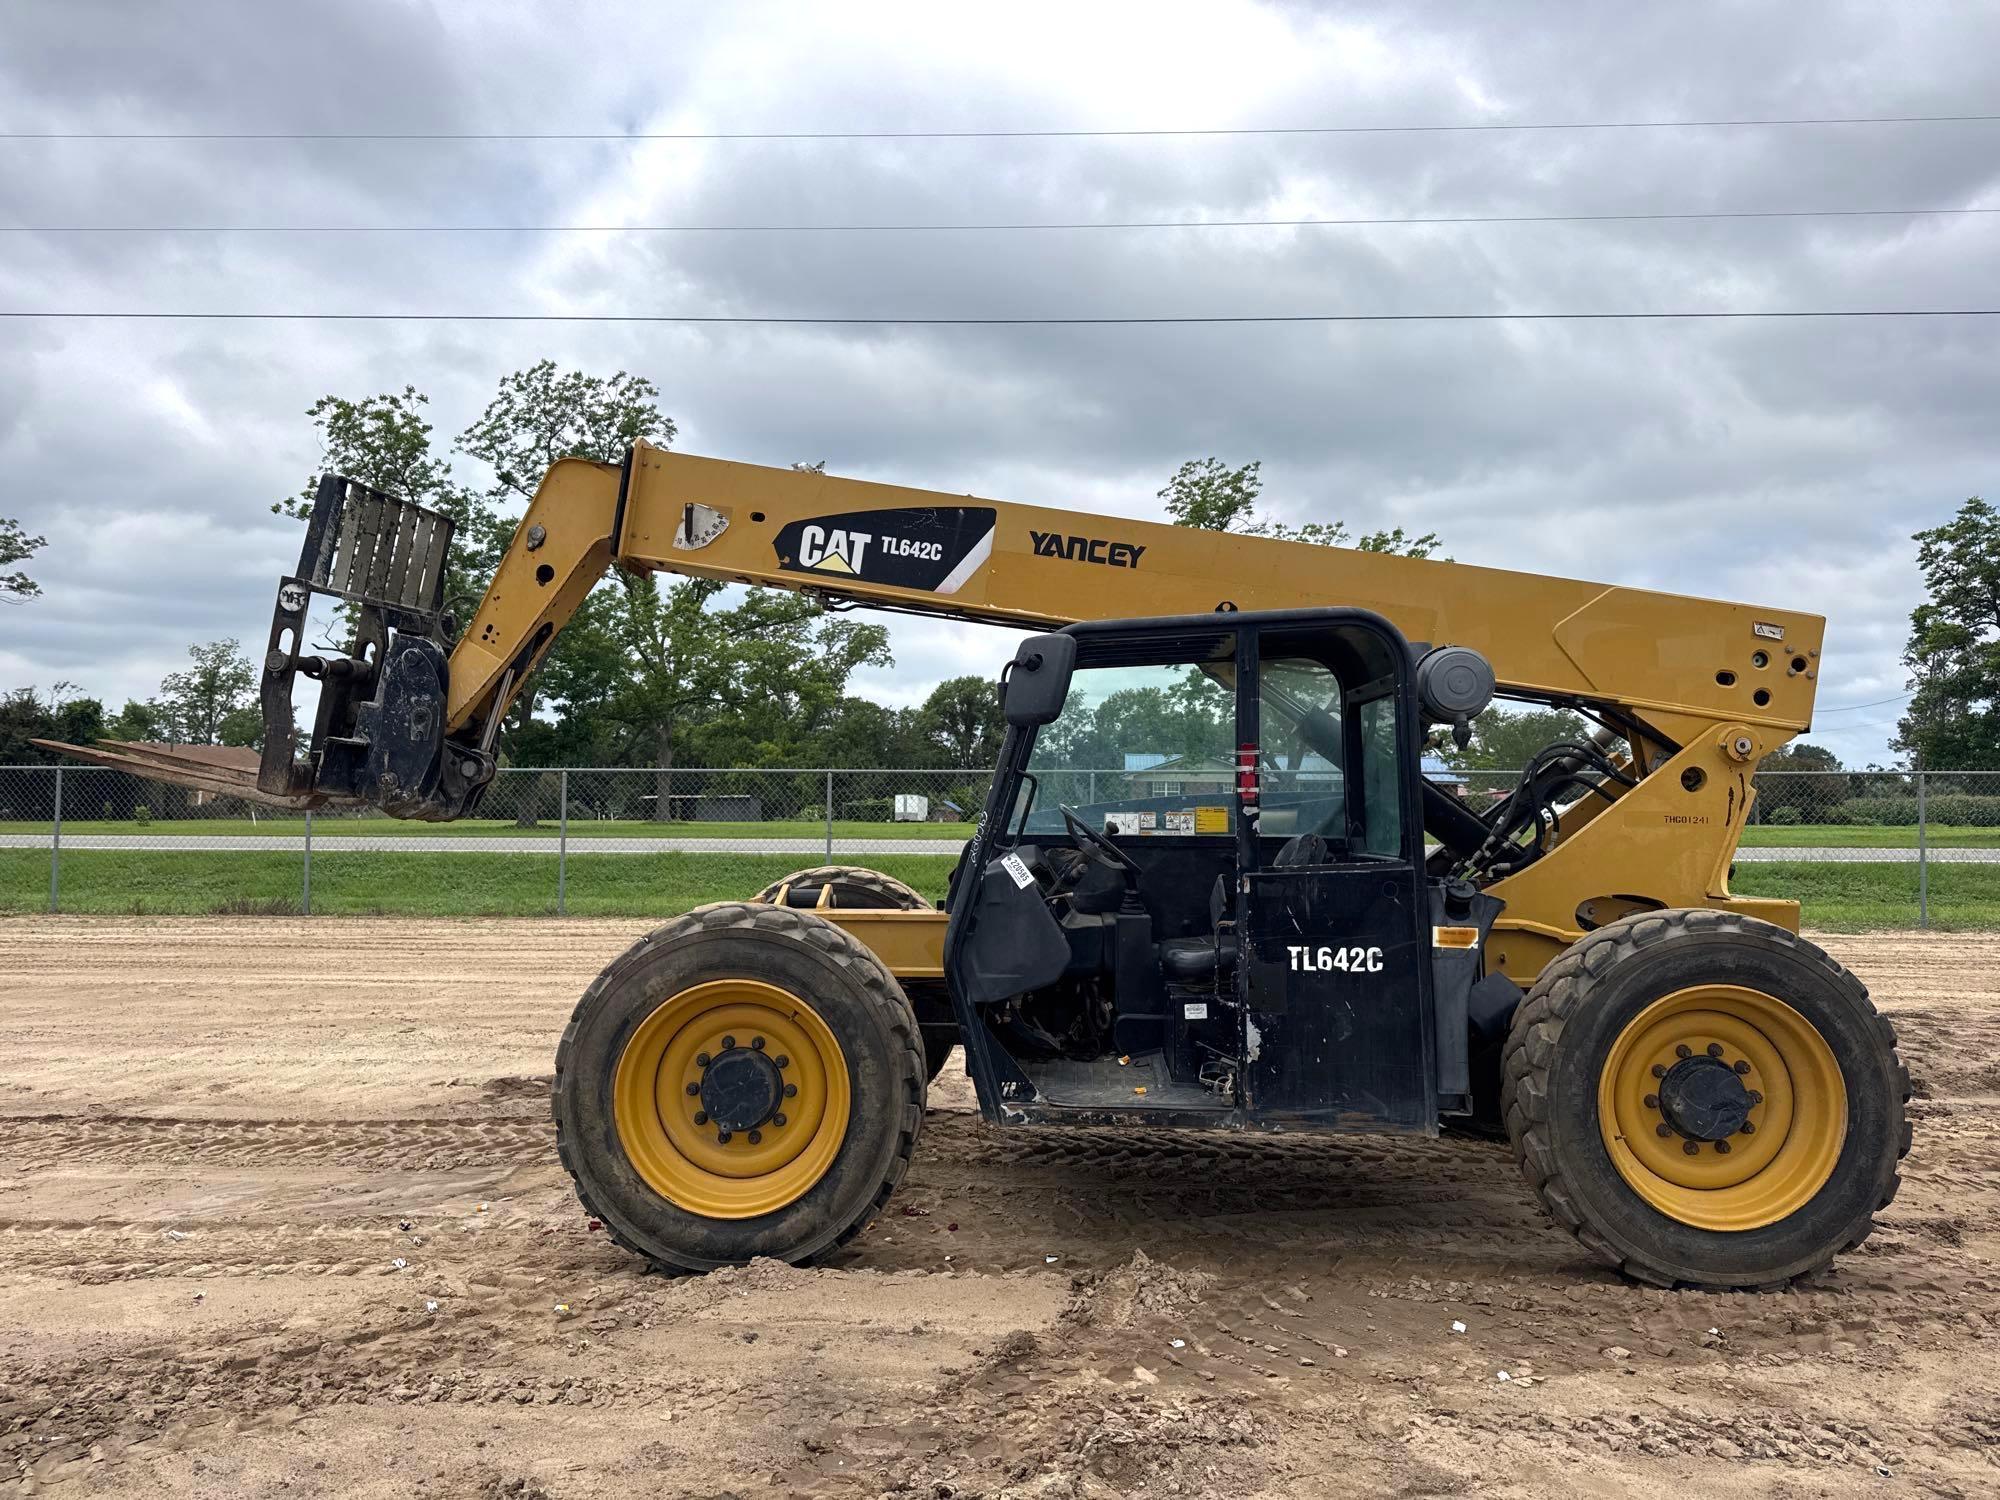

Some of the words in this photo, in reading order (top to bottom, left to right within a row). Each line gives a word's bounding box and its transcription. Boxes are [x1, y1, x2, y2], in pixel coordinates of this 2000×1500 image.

[799, 525, 872, 575] CAT
[881, 536, 943, 561] TL642C
[1029, 530, 1147, 569] YANCEY
[1664, 815, 1709, 824] THG01241
[1287, 946, 1384, 972] TL642C
